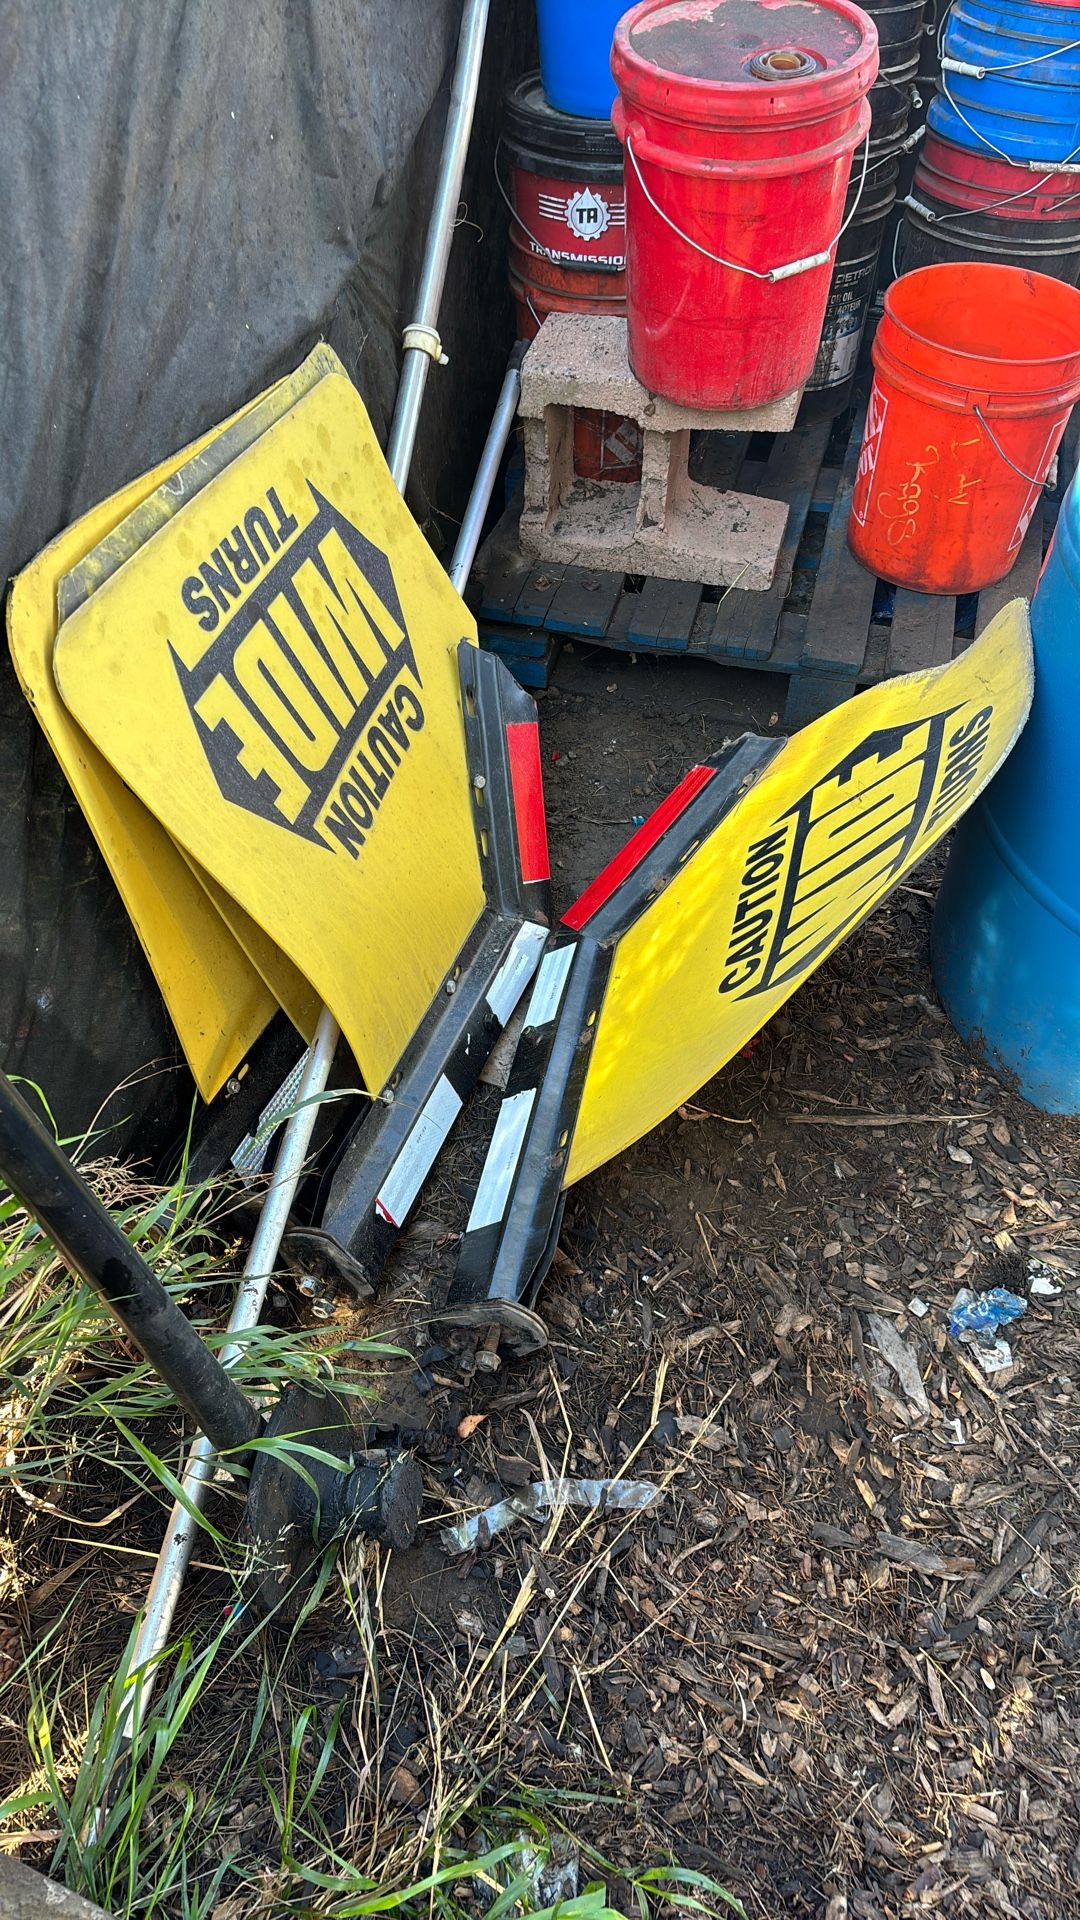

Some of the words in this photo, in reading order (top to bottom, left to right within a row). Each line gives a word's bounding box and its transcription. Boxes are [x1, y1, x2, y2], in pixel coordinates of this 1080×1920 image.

[529, 240, 626, 267] TRANSMISSIO
[575, 207, 599, 224] TA
[181, 486, 299, 632] TURNS
[193, 527, 406, 826] WIDE
[322, 683, 425, 861] CAUTION
[922, 705, 994, 836] TURNS
[717, 825, 789, 994] CAUTION
[768, 719, 932, 987] WIDE
